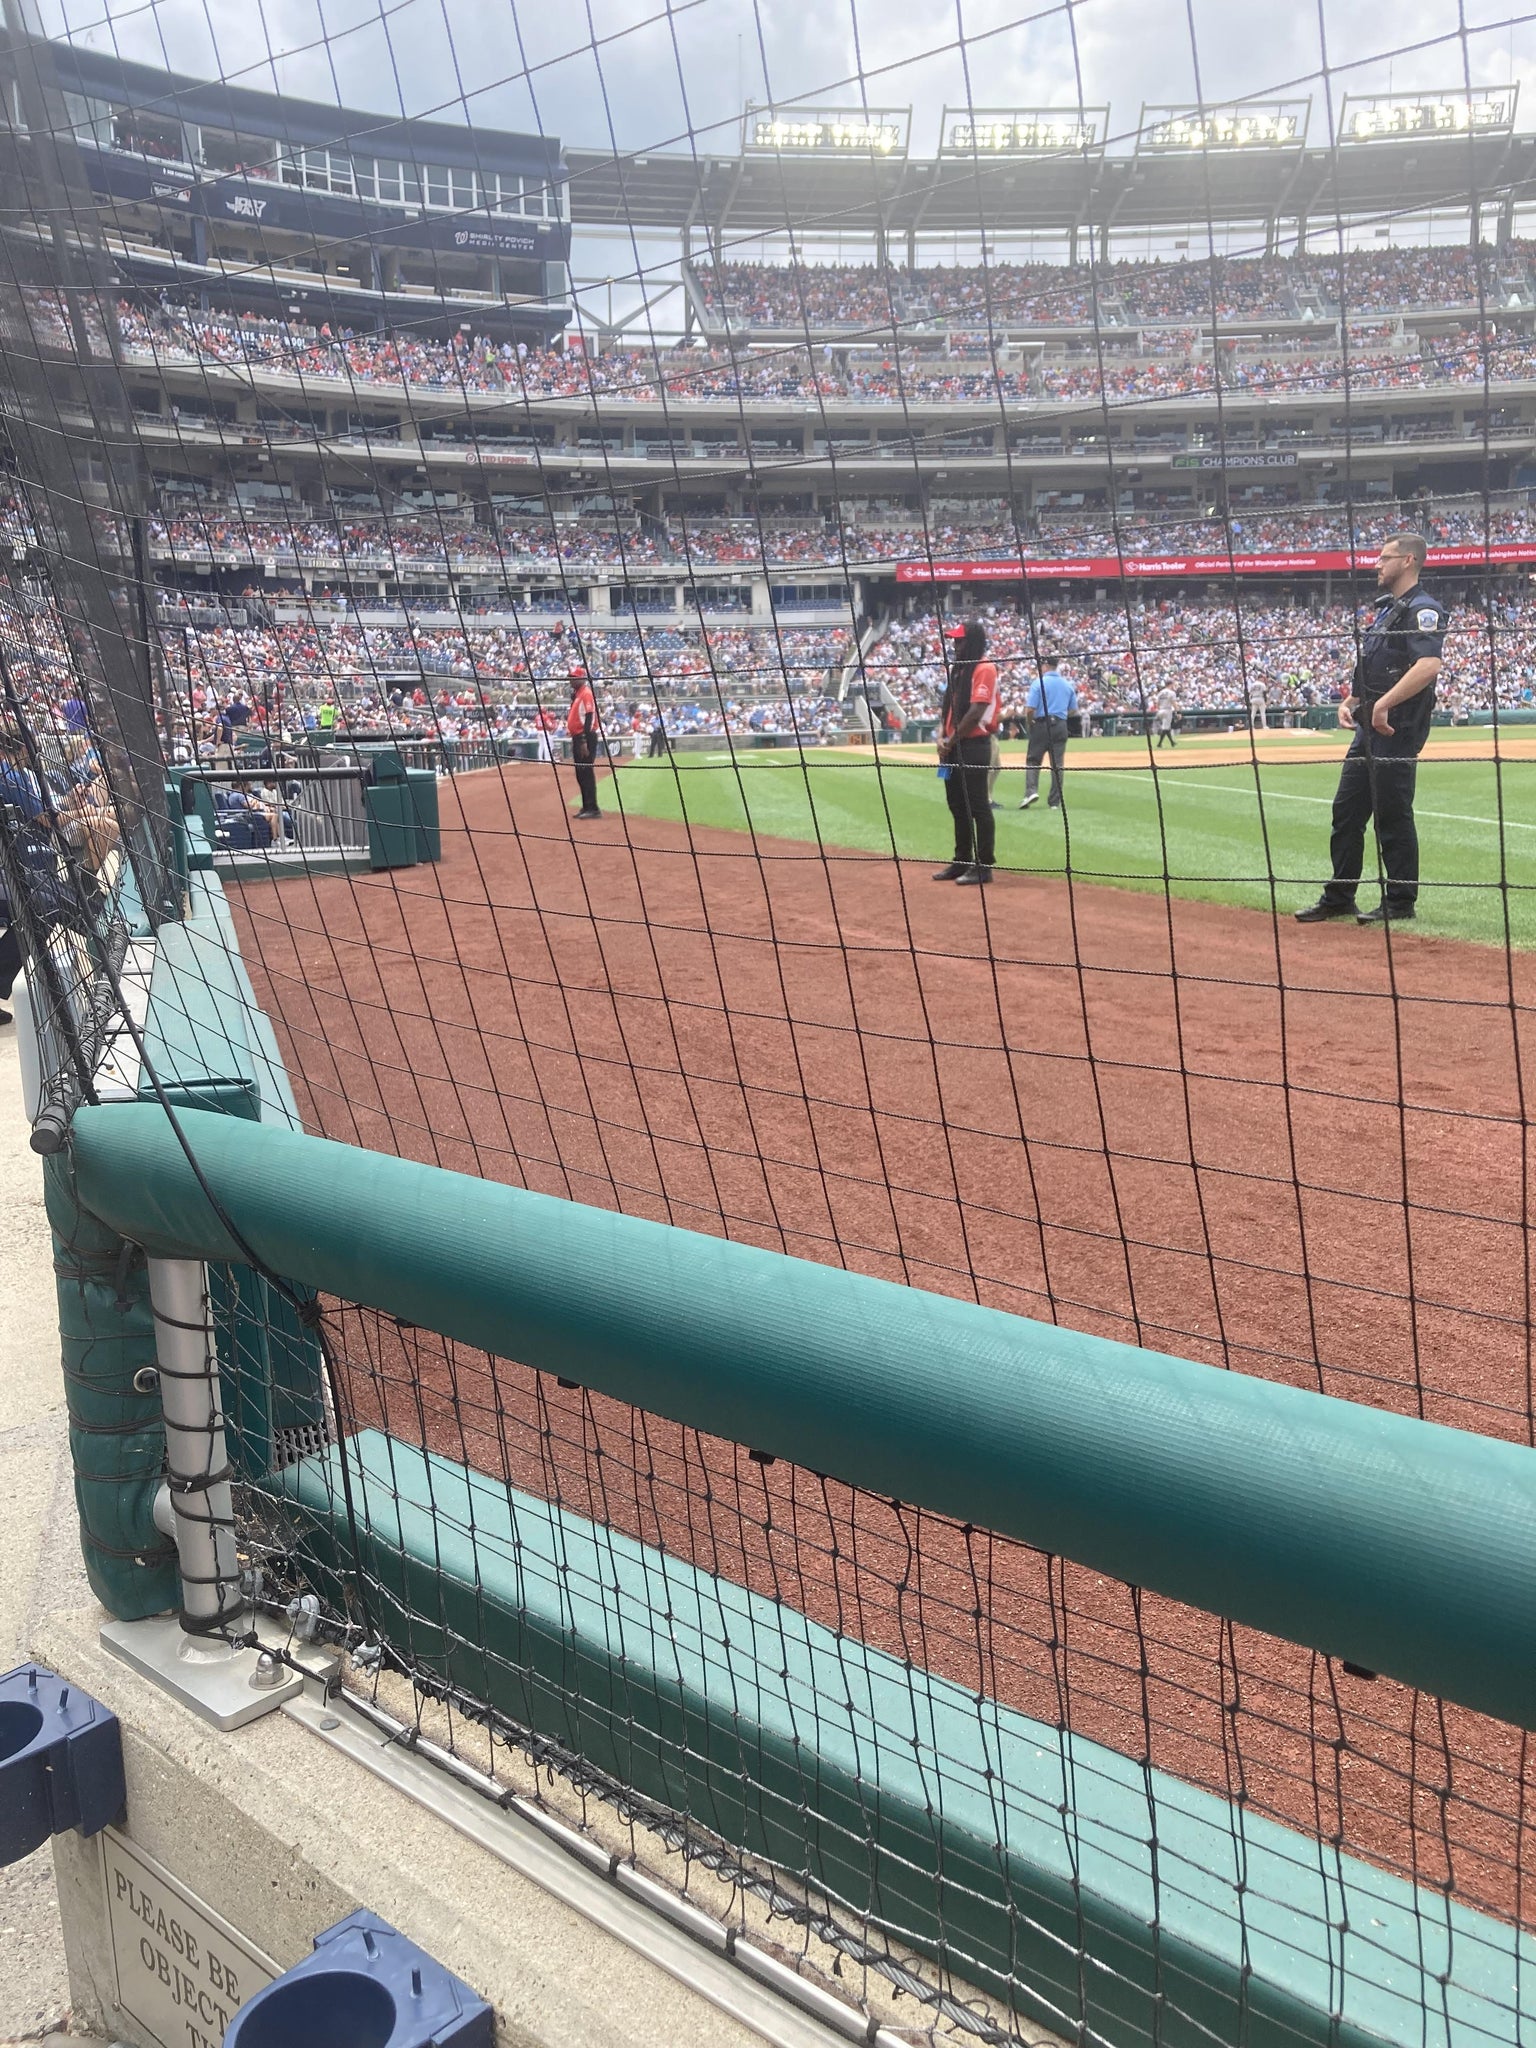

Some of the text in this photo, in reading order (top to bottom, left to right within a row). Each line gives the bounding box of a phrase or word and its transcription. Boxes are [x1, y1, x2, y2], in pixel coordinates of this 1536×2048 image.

[505, 236, 535, 244] POVICH
[499, 242, 534, 250] CENTER
[1202, 456, 1265, 467] CHAMPIONS
[1267, 454, 1295, 465] CLUB
[1482, 551, 1518, 559] Washington
[1518, 549, 1536, 557] Nation
[1139, 561, 1186, 571] Harris Teeter
[1194, 561, 1215, 569] Official
[1216, 560, 1237, 568] Partner
[1255, 559, 1288, 567] Washington
[1288, 558, 1316, 566] Nationals
[992, 566, 1013, 575] Partner
[1030, 566, 1063, 574] Washington
[1063, 565, 1091, 573] Nationals
[114, 1867, 241, 2006] PLEASE BE
[140, 1937, 235, 2038] OBJECT
